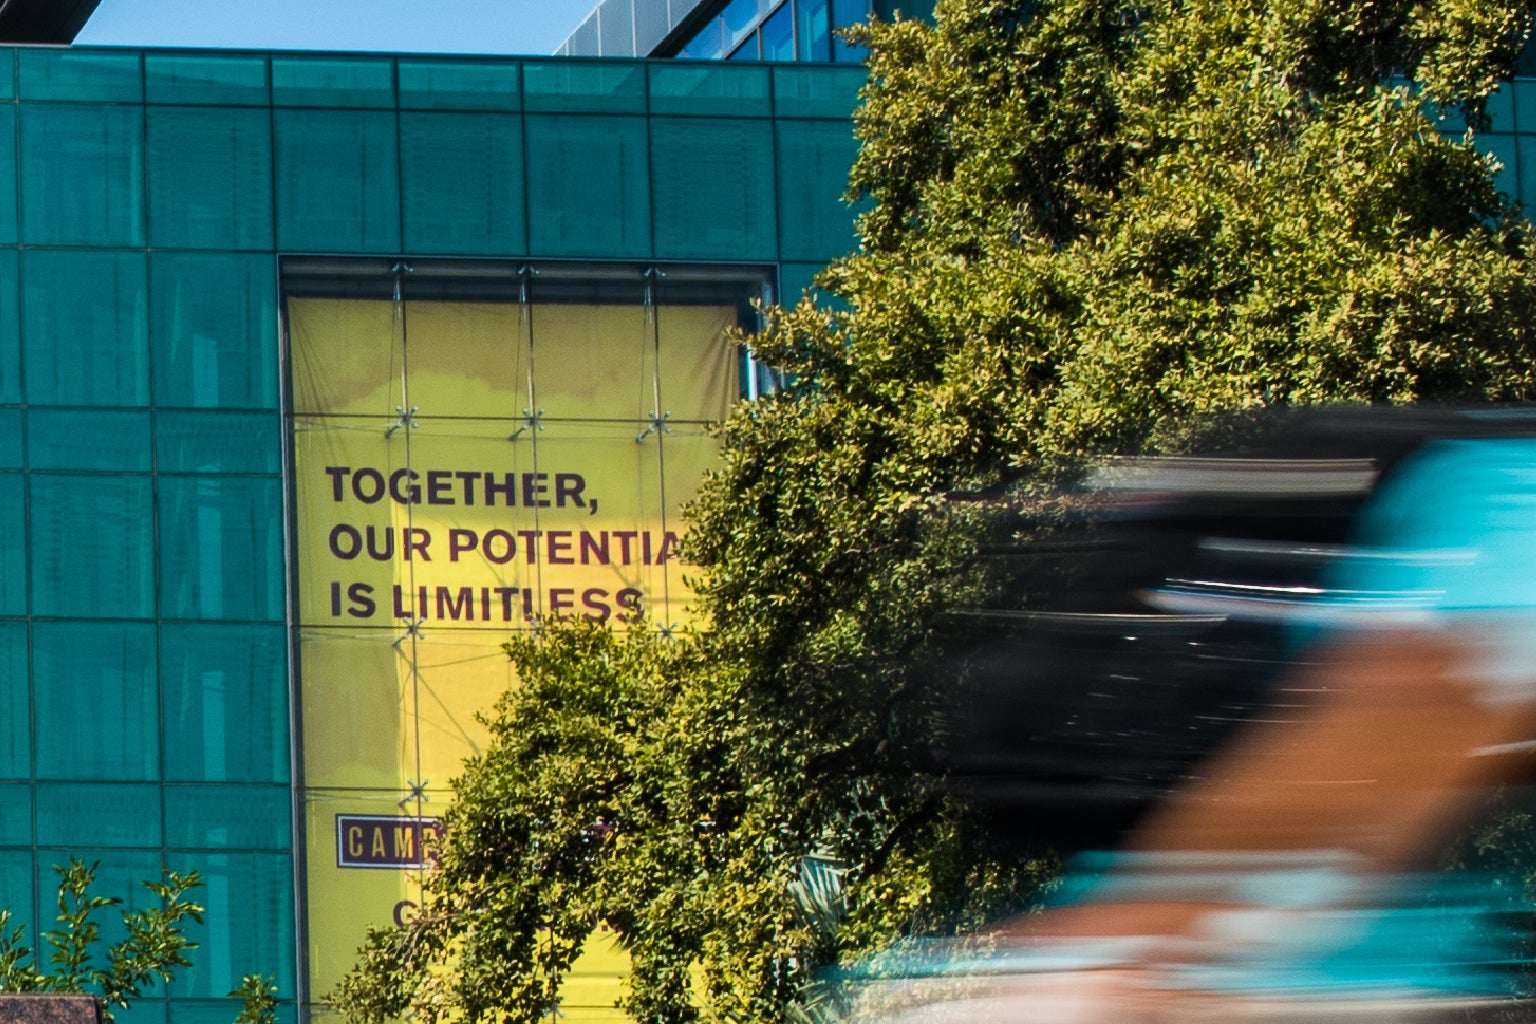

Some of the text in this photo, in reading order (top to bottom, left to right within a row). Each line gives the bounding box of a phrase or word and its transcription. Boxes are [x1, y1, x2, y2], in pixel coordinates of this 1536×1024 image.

[325, 465, 598, 516] TOGETHER,
[328, 523, 680, 567] OUR POTENTIA
[330, 582, 376, 619] IS
